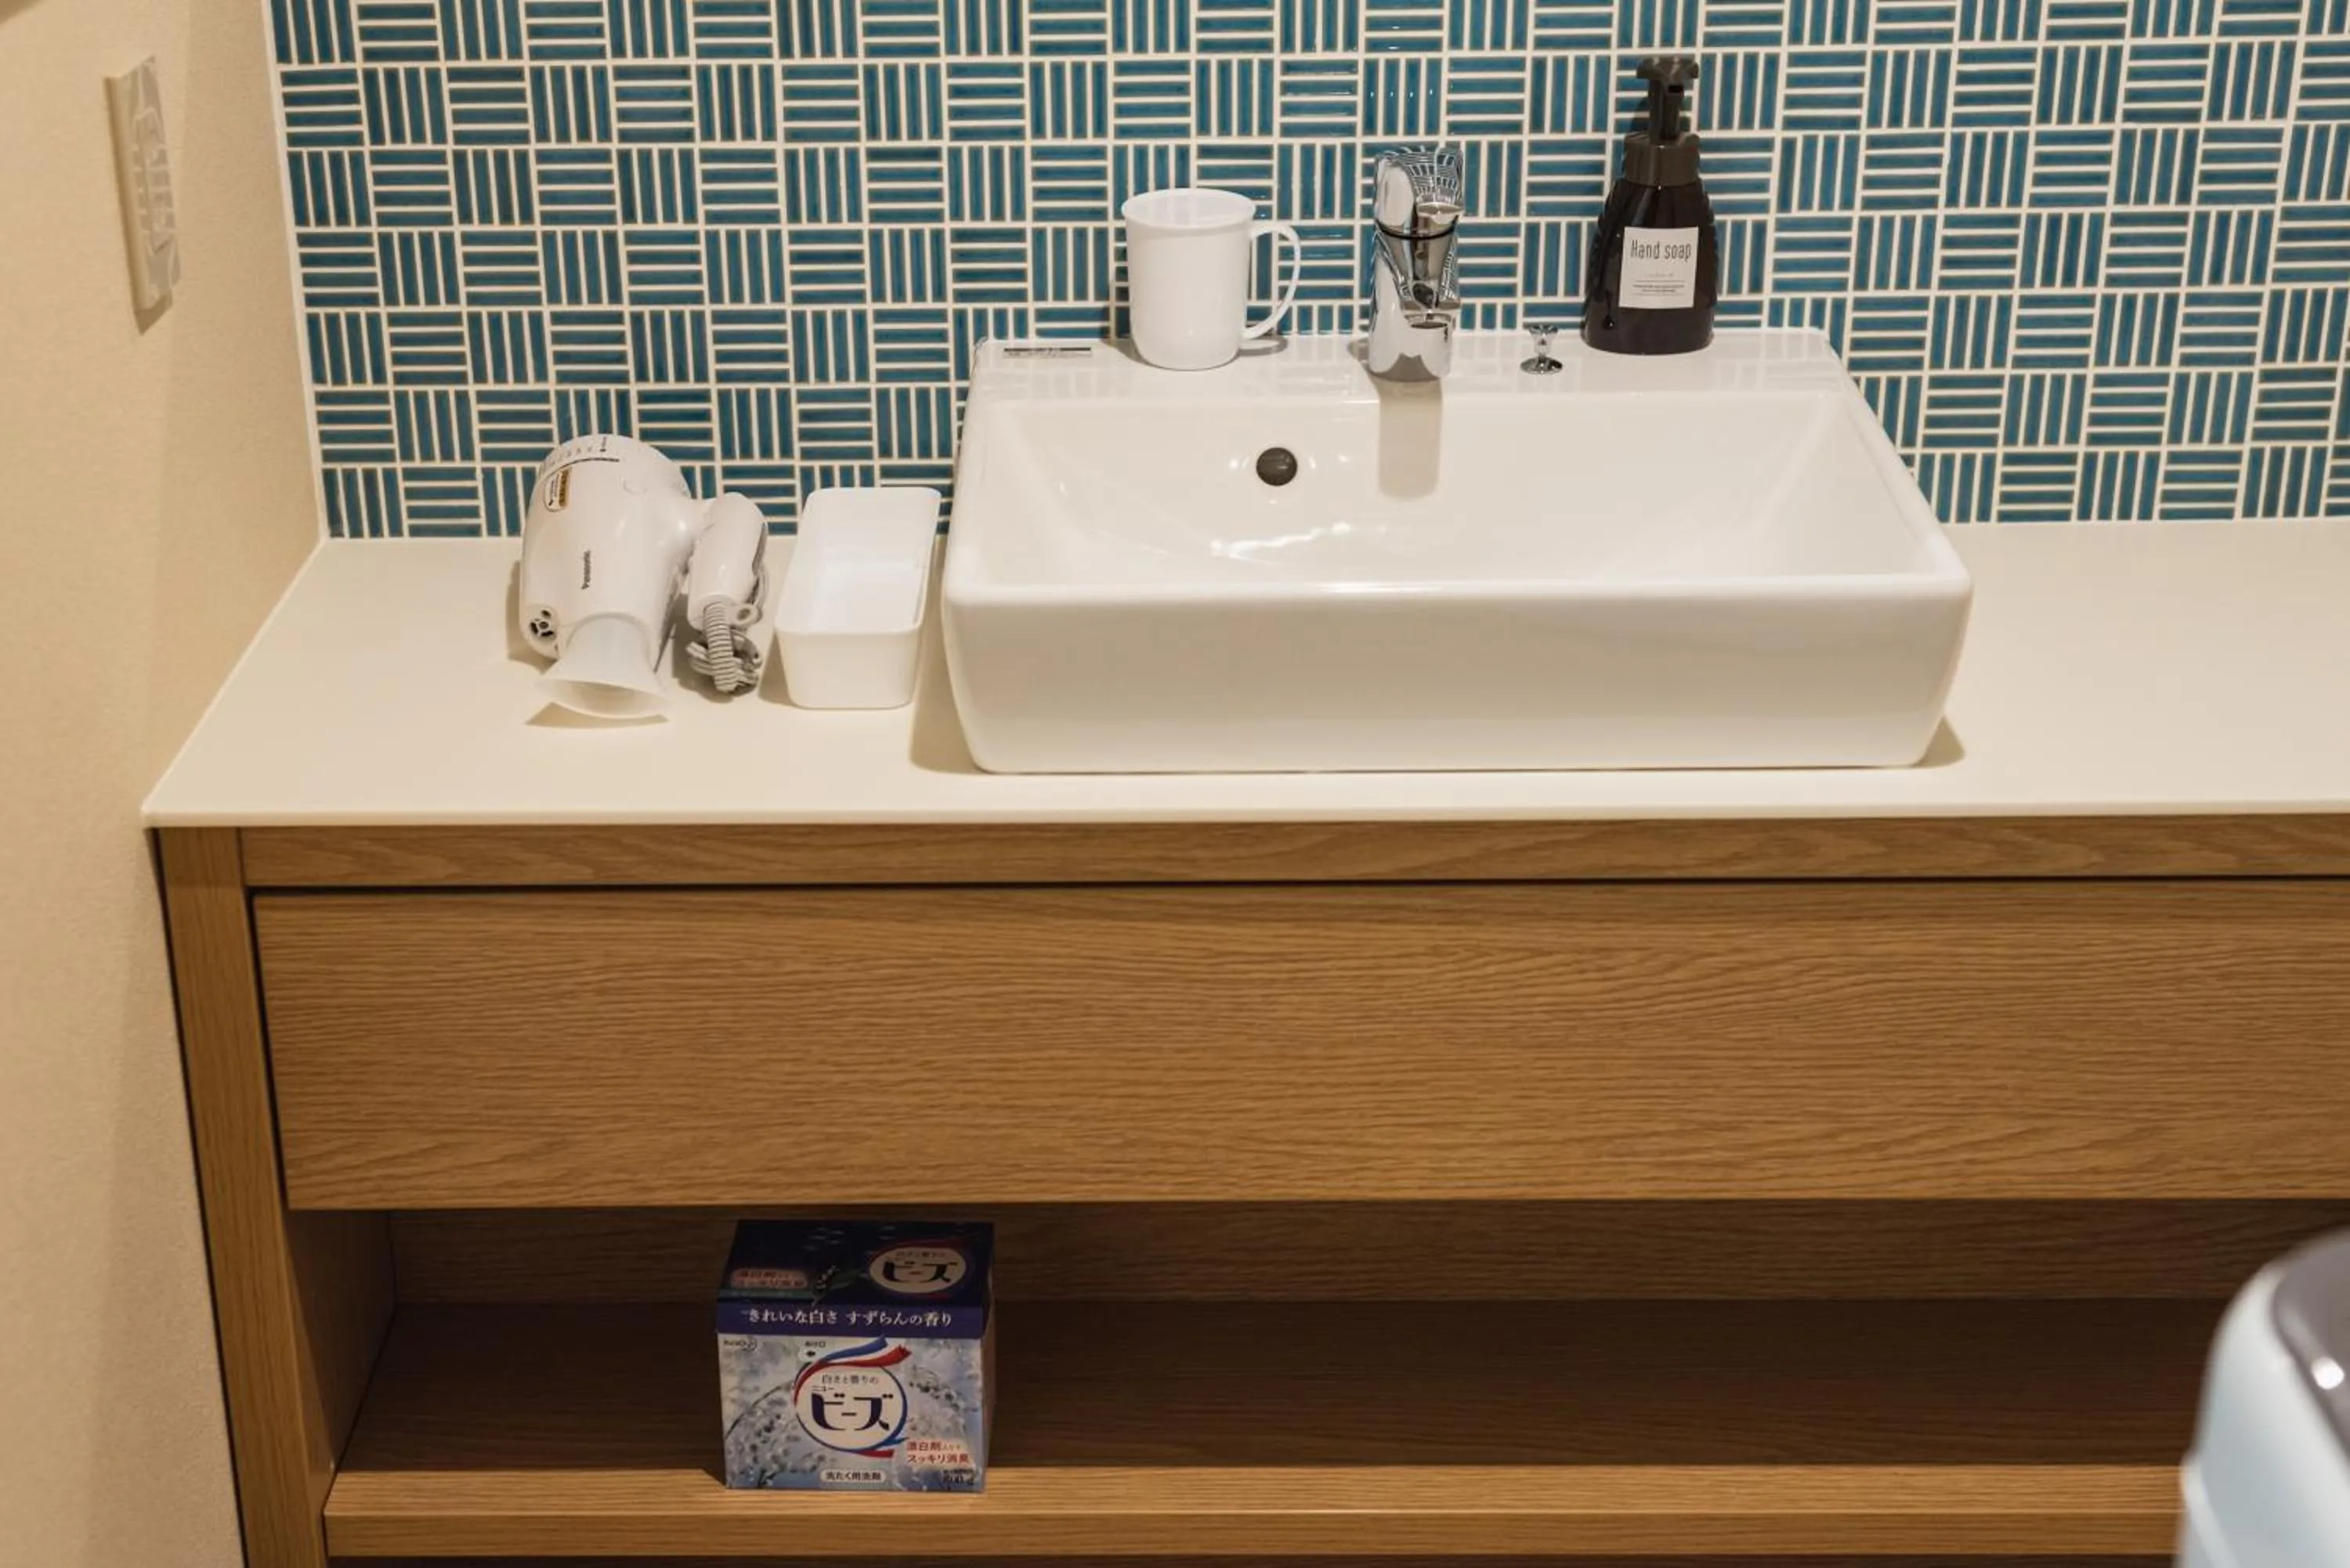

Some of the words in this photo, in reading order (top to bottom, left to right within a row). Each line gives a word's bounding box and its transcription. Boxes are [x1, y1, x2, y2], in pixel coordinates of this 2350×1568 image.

[1630, 239, 1661, 259] Hand
[1664, 241, 1692, 263] soap
[882, 1260, 959, 1283] ビーズ
[748, 1308, 838, 1324] きれいな白さ
[846, 1310, 953, 1328] すずらんの香り
[811, 1393, 894, 1432] ビーズ
